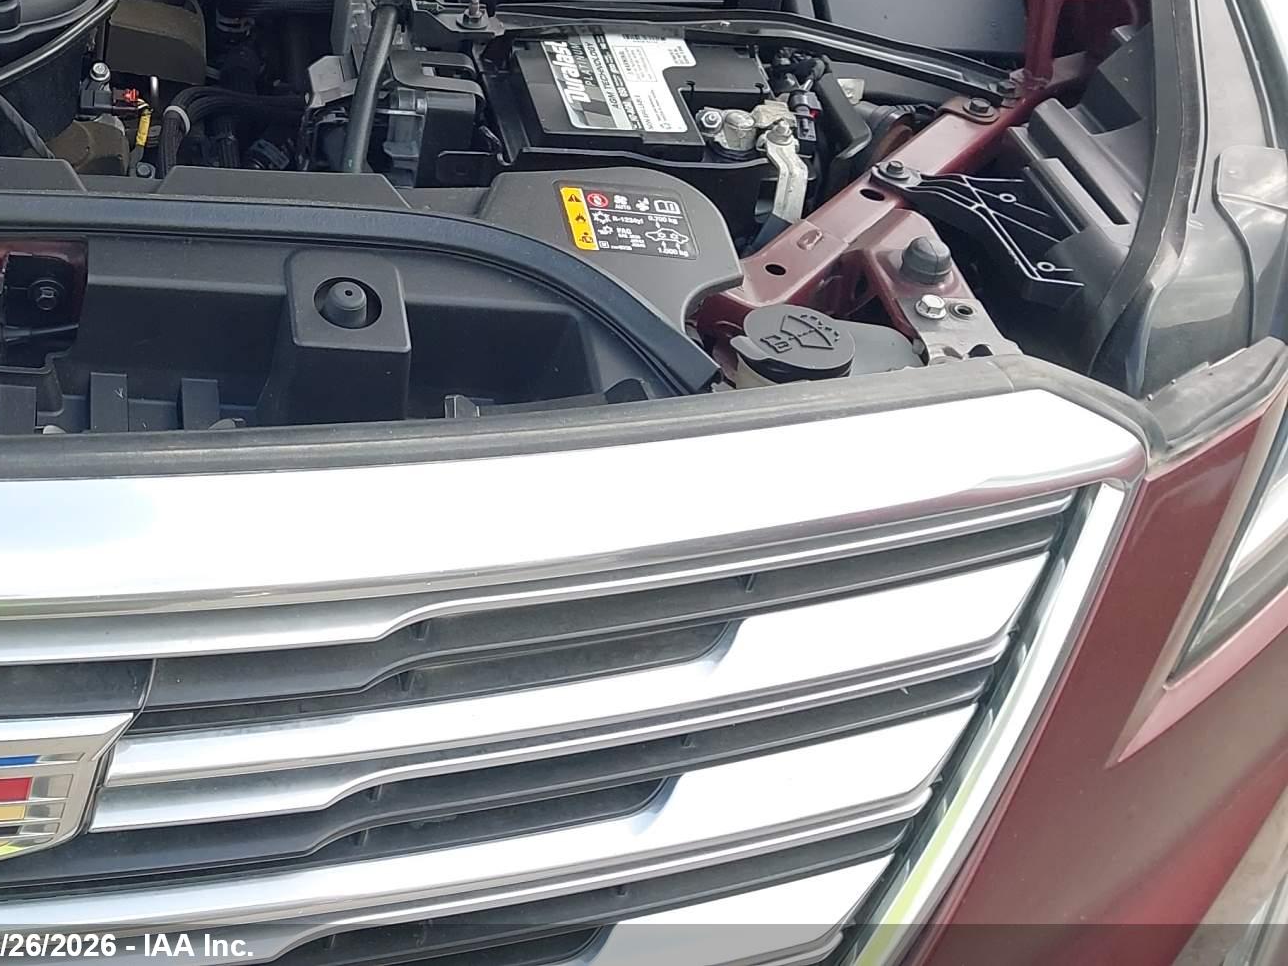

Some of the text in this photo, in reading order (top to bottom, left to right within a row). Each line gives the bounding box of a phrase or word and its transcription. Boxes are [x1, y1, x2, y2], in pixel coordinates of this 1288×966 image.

[544, 40, 592, 104] Duralast
[569, 41, 595, 88] PLATINUM
[584, 40, 612, 90] TECHNOLOGY
